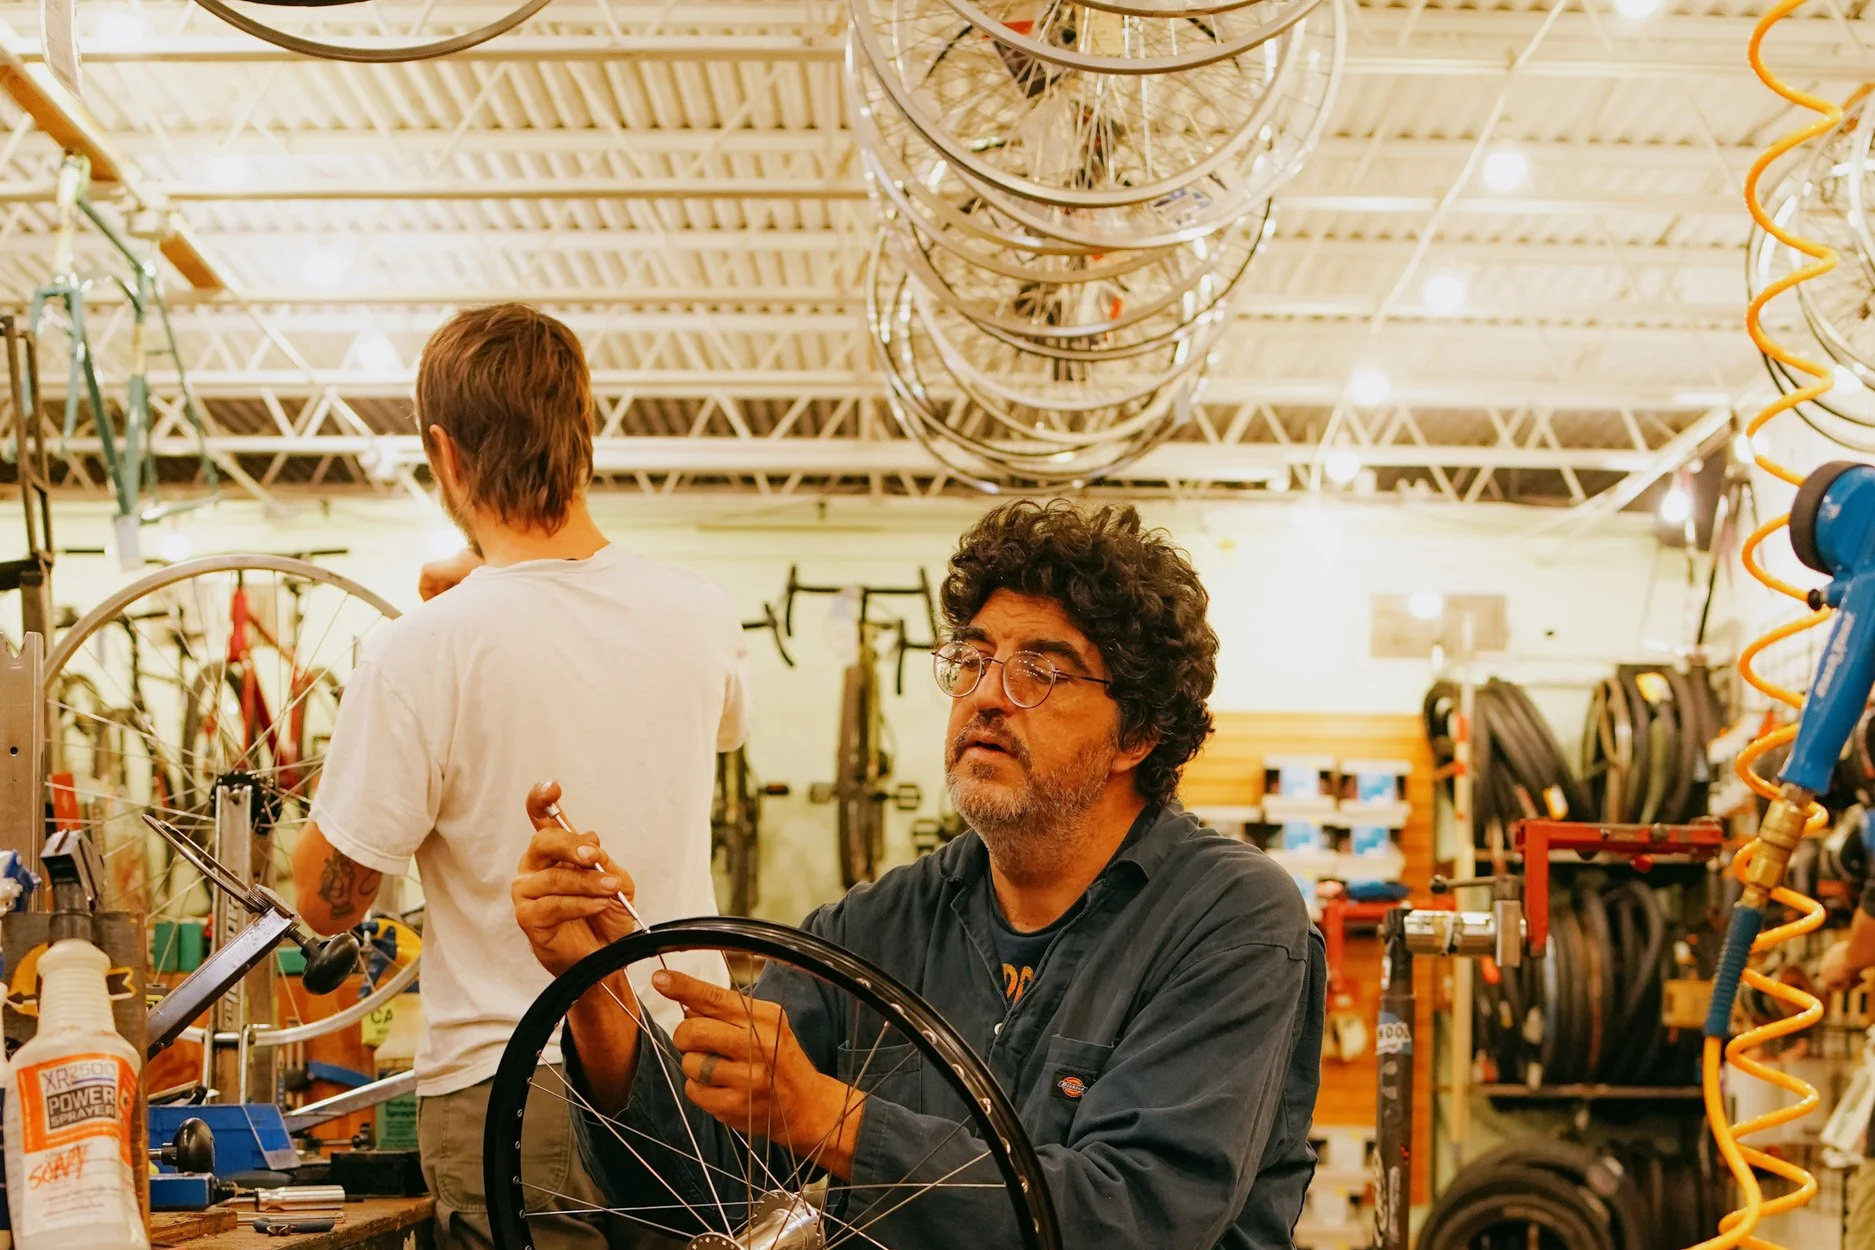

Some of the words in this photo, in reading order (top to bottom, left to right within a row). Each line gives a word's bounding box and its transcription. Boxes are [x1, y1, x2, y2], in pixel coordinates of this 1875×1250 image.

[42, 1062, 117, 1093] XR2500
[49, 1085, 116, 1116] POWER
[50, 1104, 116, 1129] SPRAYER
